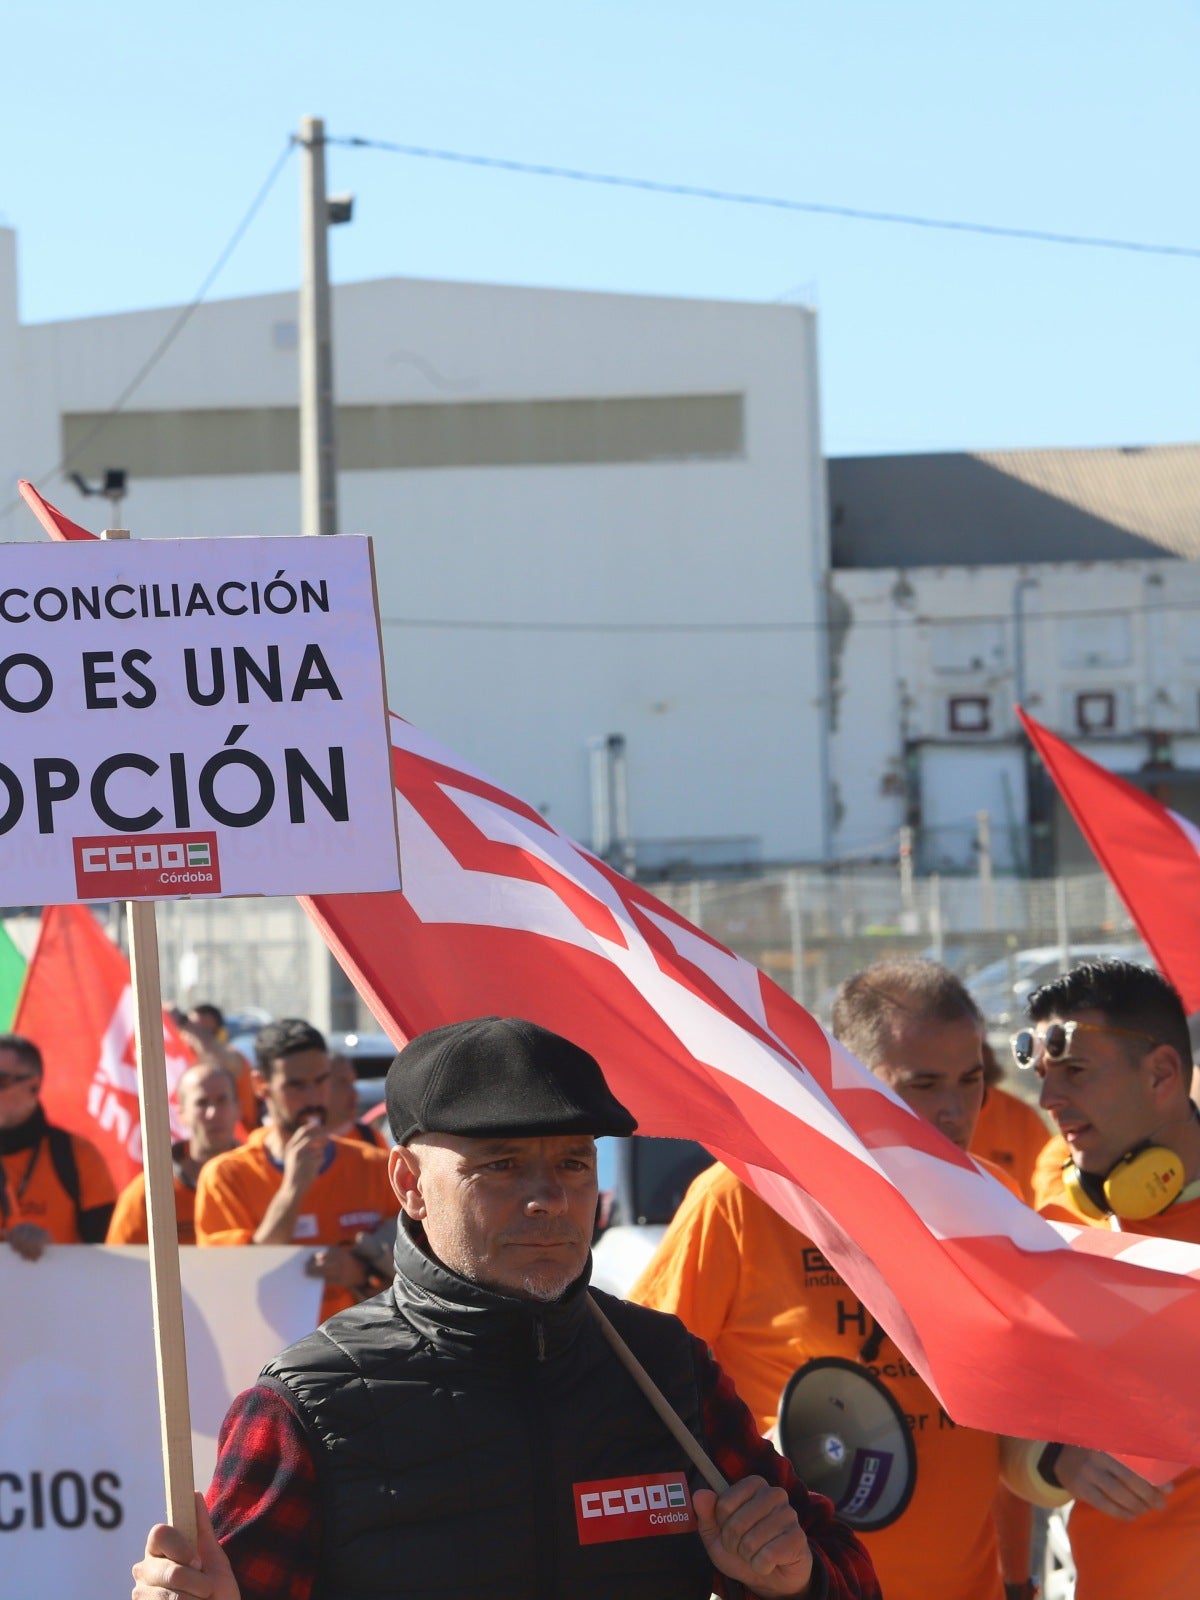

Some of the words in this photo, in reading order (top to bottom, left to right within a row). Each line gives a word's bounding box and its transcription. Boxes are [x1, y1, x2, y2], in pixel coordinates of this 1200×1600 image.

[82, 648, 157, 710] ES
[184, 644, 343, 706] UNA
[82, 843, 186, 872] CCOO
[160, 872, 213, 884] Córdoba
[580, 1484, 668, 1519] CCOO
[649, 1512, 689, 1525] Córdoba
